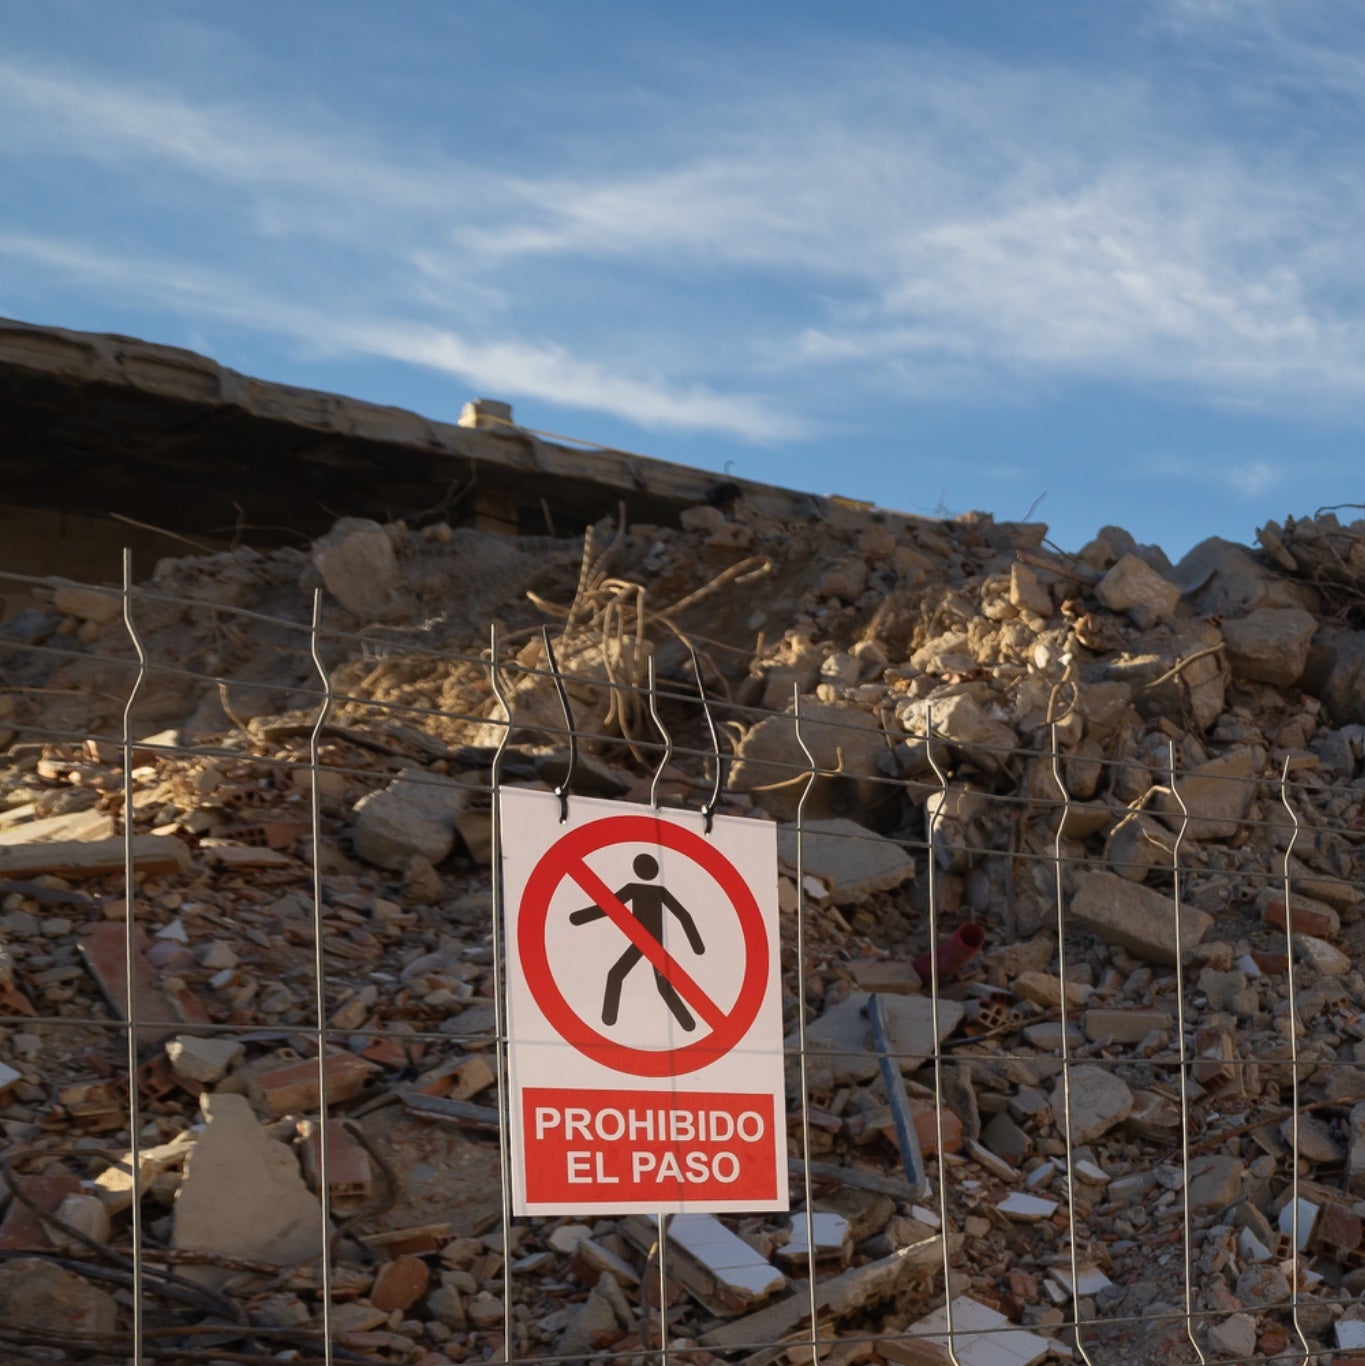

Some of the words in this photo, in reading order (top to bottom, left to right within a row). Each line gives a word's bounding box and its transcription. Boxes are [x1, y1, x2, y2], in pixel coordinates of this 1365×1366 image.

[534, 1106, 765, 1143] PROHIBIDO
[566, 1150, 620, 1184] EL
[631, 1150, 741, 1184] PASO
